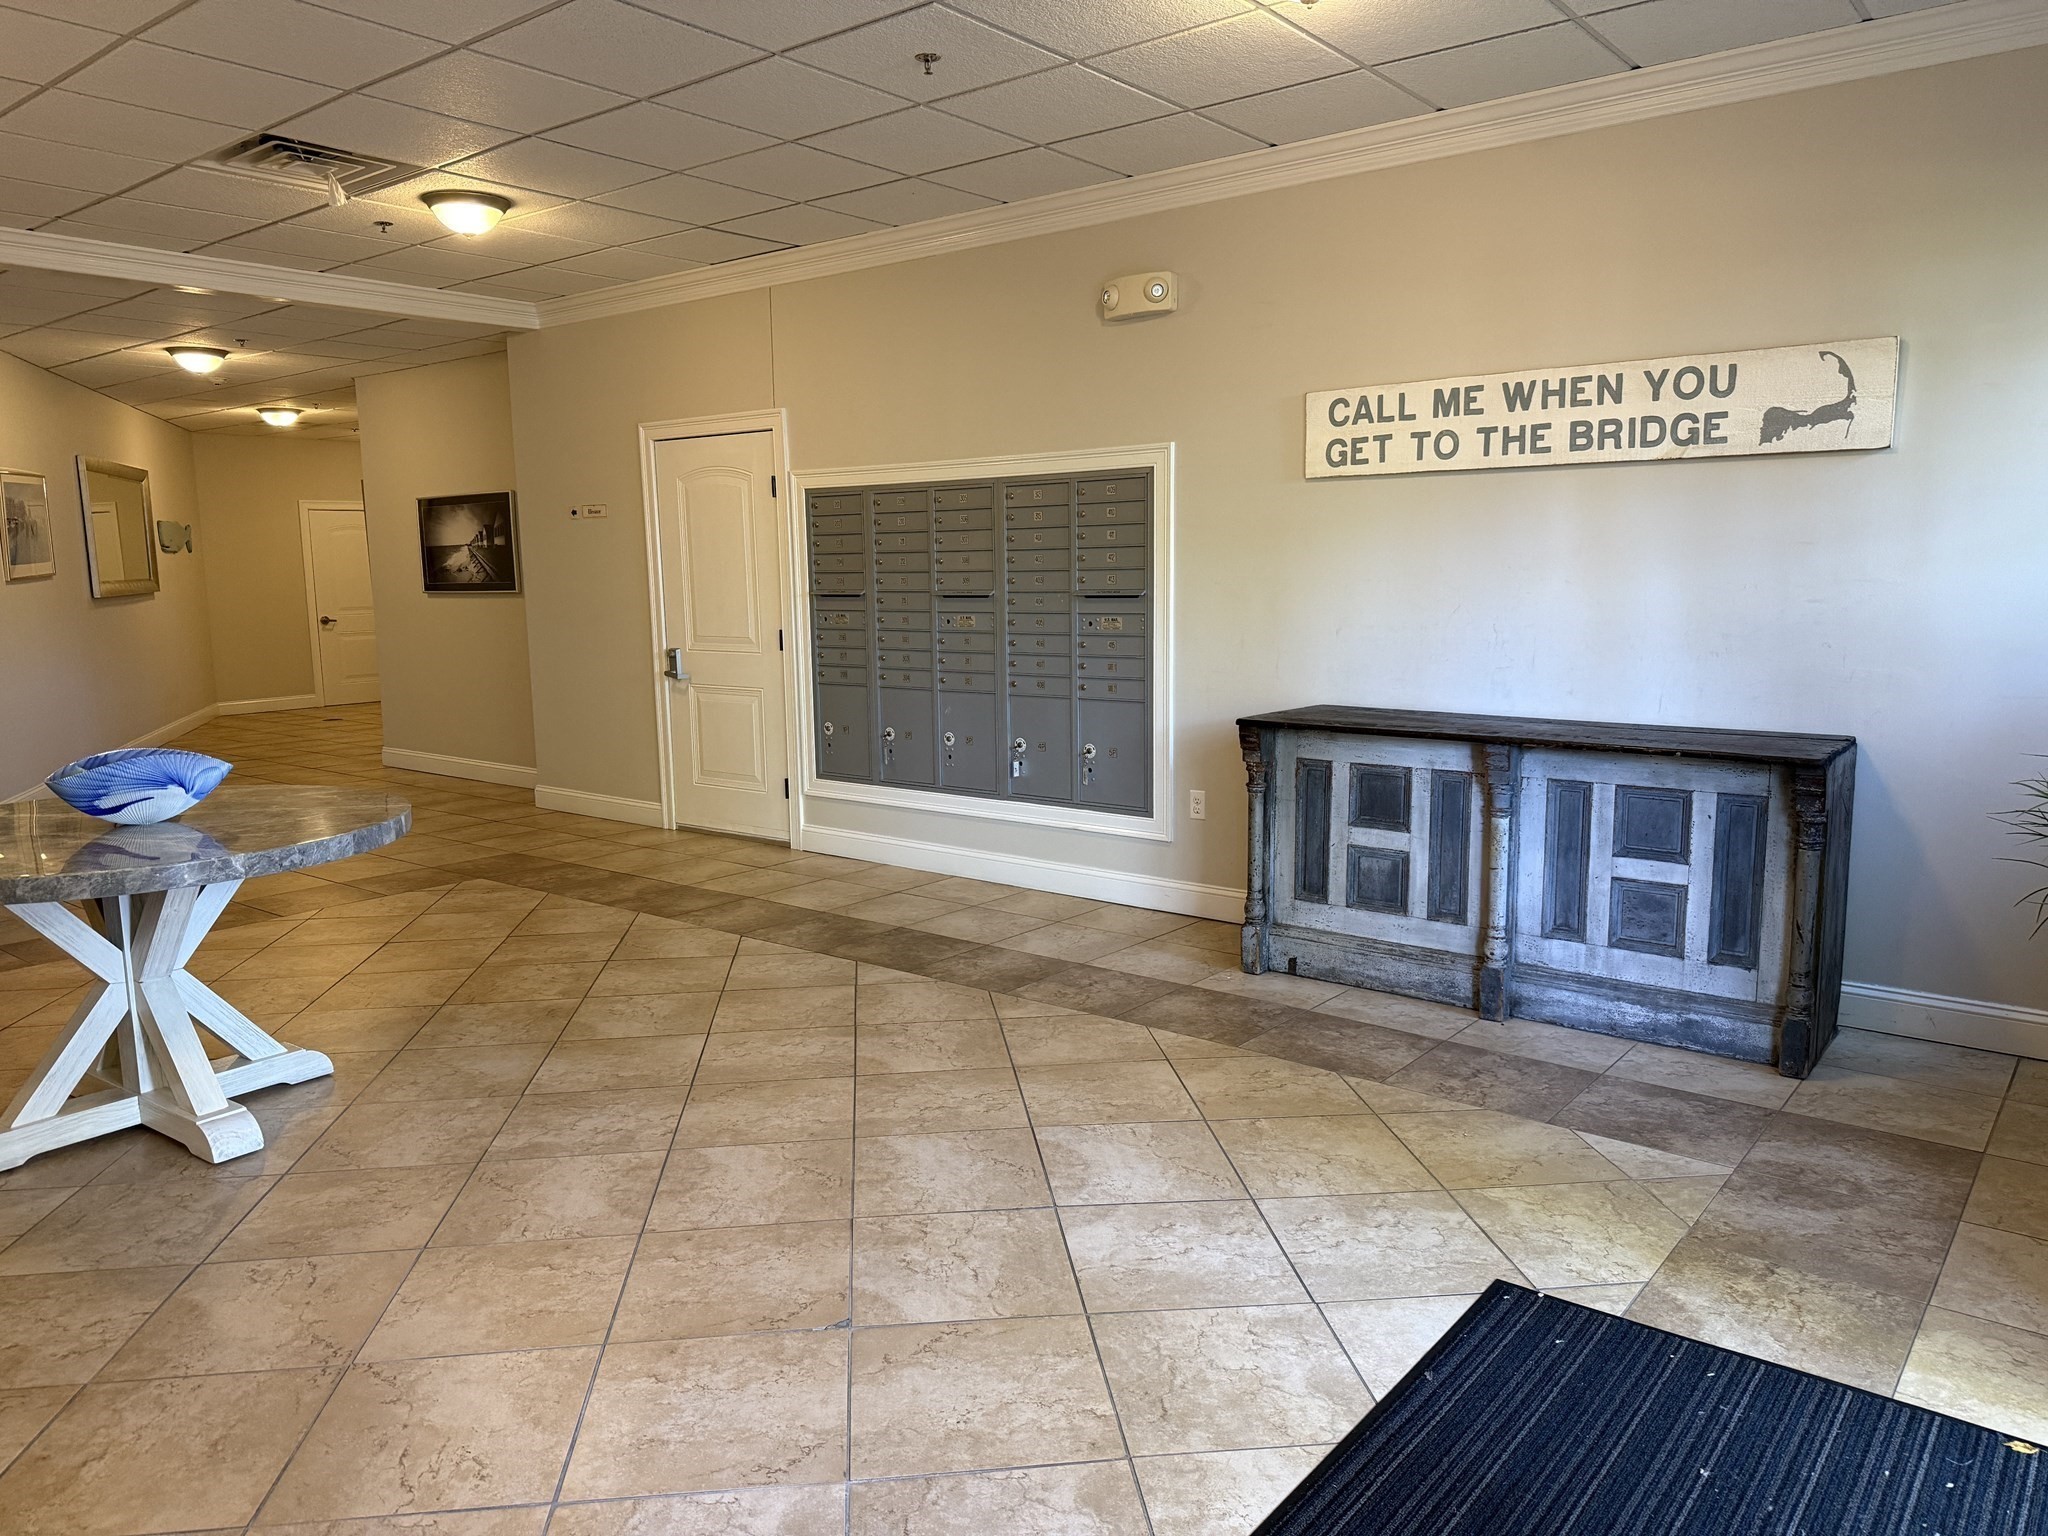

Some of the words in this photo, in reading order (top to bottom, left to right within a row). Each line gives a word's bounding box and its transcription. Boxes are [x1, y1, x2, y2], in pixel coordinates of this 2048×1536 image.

[1328, 392, 1415, 427] CALL
[1433, 385, 1485, 419] ME
[1502, 372, 1624, 413] WHEN
[1643, 363, 1738, 401] YOU
[1325, 433, 1393, 469] GET
[1410, 429, 1459, 462] TO
[1477, 422, 1552, 457] THE
[1568, 411, 1729, 453] BRIDGE
